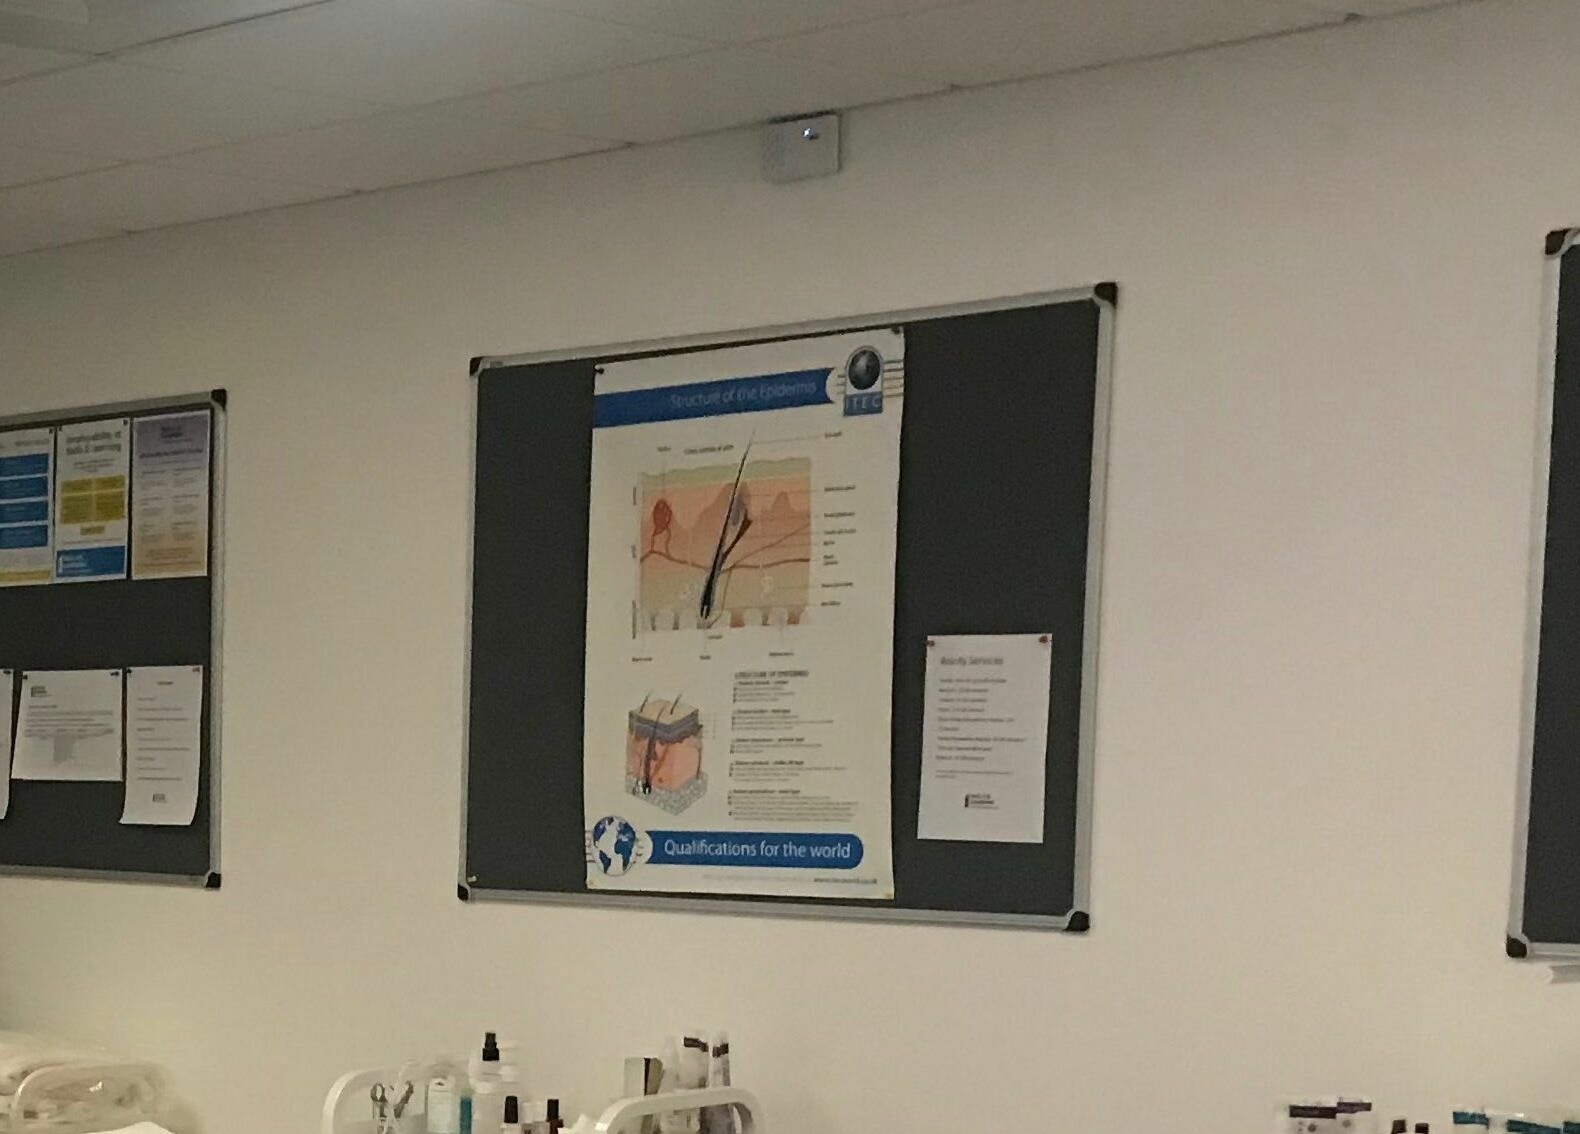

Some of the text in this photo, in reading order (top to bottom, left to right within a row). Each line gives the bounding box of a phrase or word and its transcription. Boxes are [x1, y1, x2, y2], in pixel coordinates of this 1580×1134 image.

[664, 839, 851, 859] Qualifications for the world
